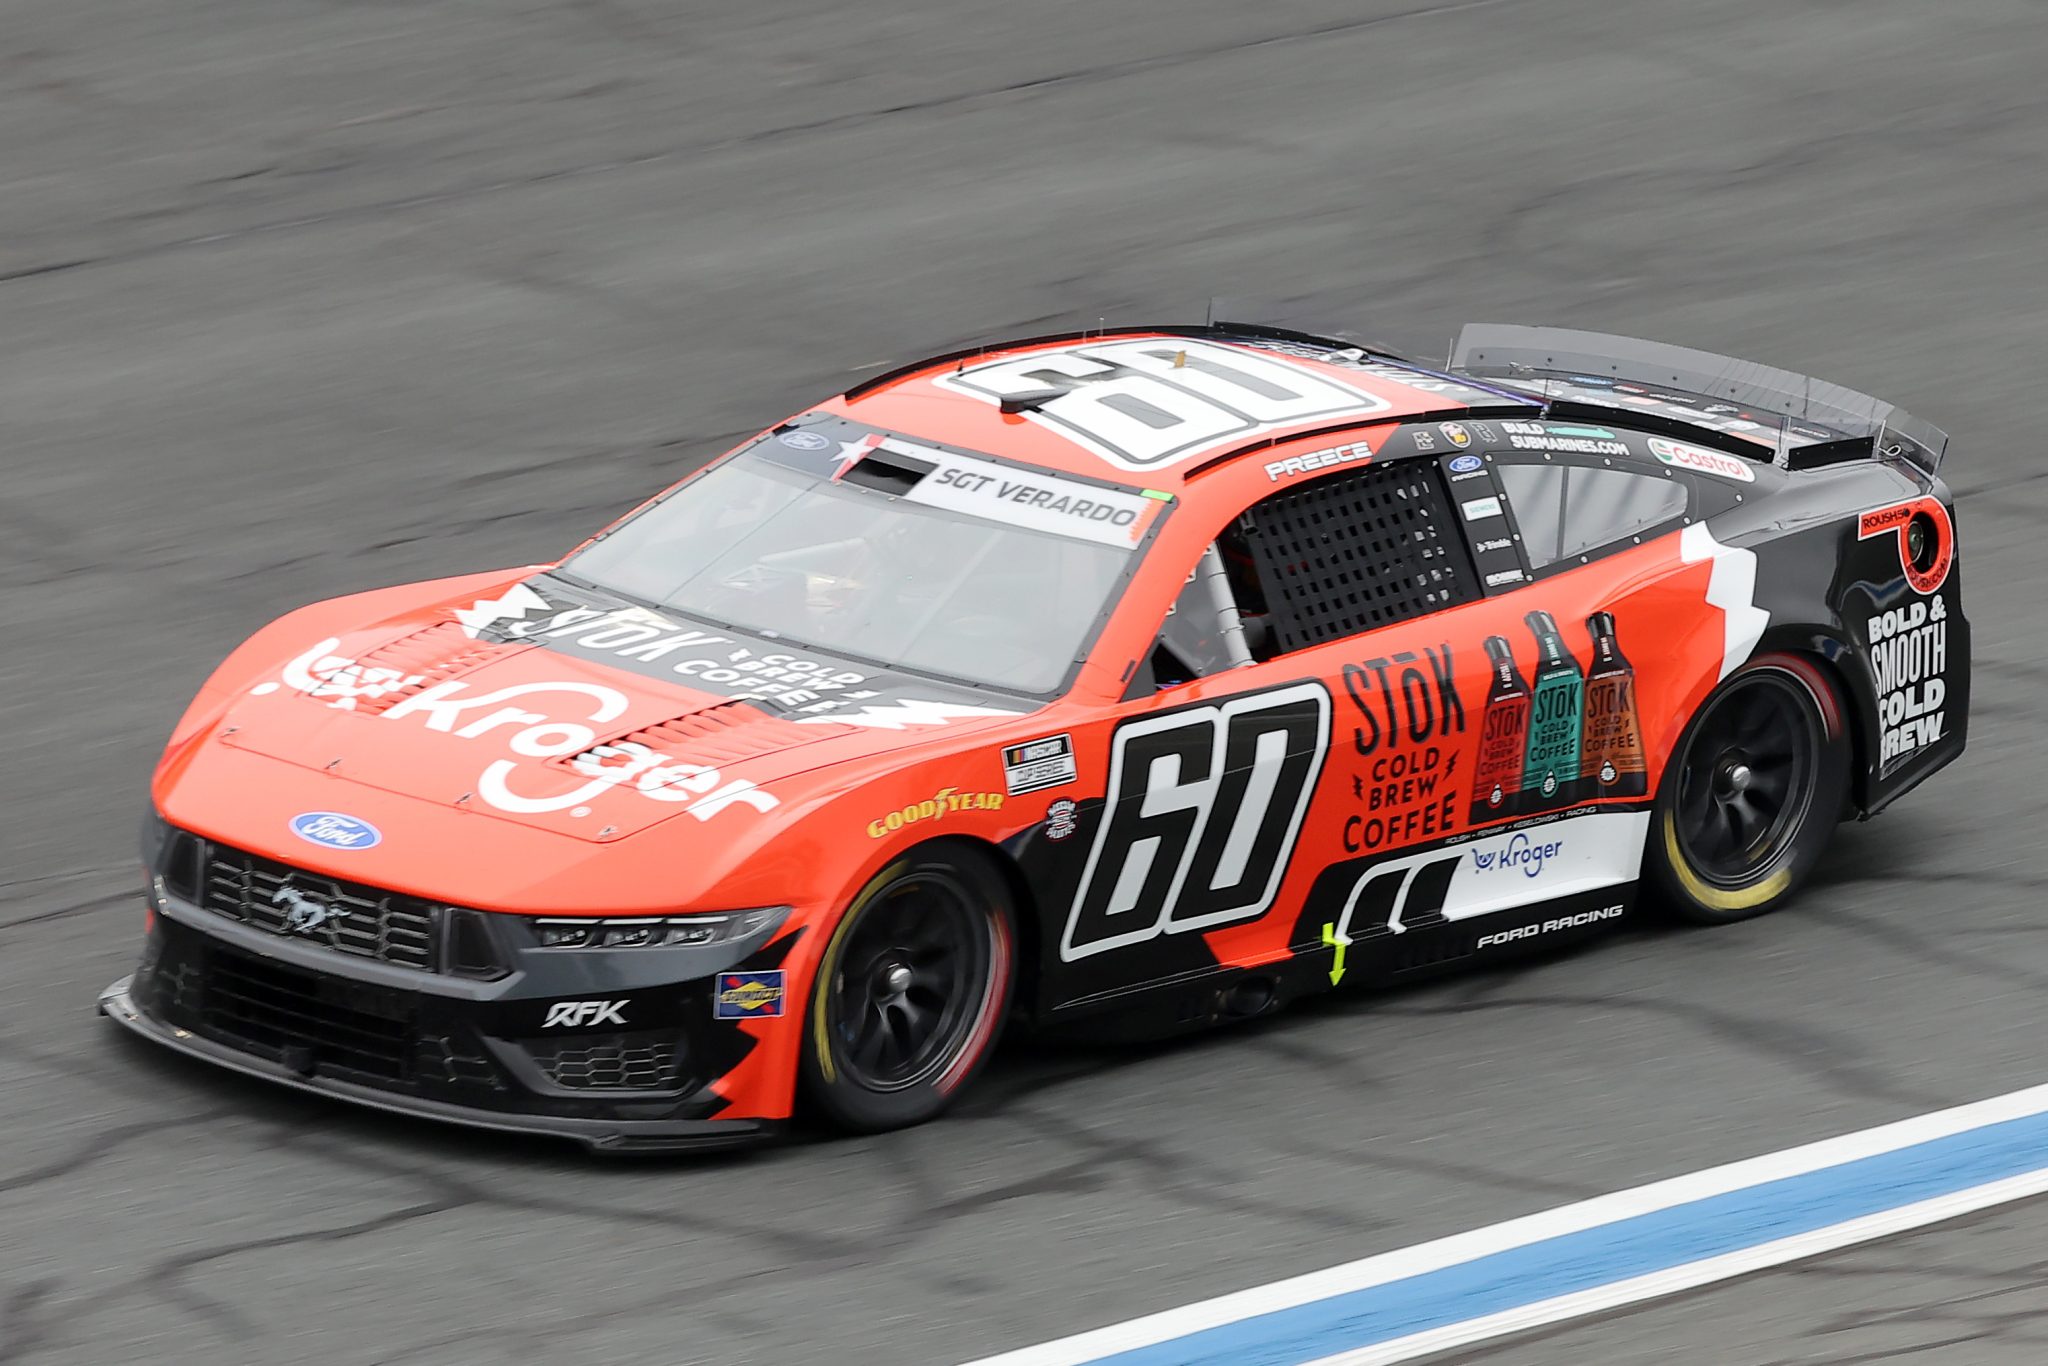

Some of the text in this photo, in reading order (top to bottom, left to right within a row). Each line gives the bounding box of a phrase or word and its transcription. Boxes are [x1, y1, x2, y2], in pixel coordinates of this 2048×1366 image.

[945, 338, 1380, 465] 60
[1501, 422, 1545, 435] BUILD
[1510, 435, 1631, 456] SUBMARINES.COM
[1264, 441, 1374, 482] PREECE
[1674, 447, 1747, 477] Castrol
[933, 468, 1137, 527] SGT VERARDO
[1868, 594, 1947, 644] BOLD &
[732, 660, 846, 690] BREW
[761, 654, 865, 684] COLD
[1871, 620, 1946, 699] SMOOTH
[1879, 678, 1946, 734] COLD
[1540, 732, 1568, 745] BREW
[1542, 721, 1569, 734] COLD
[1585, 733, 1634, 752] COFFEE
[379, 681, 781, 822] Kroger
[1372, 747, 1440, 783] COLD
[1531, 739, 1575, 762] COFFEE
[1368, 773, 1438, 811] BREW
[298, 815, 373, 848] Ford
[867, 787, 1004, 838] GOODYEAR
[1064, 689, 1326, 956] 60
[1343, 790, 1457, 854] COFFEE
[1499, 833, 1563, 878] Kroger
[1477, 904, 1624, 949] FORD RACING
[541, 1000, 631, 1028] RFK
